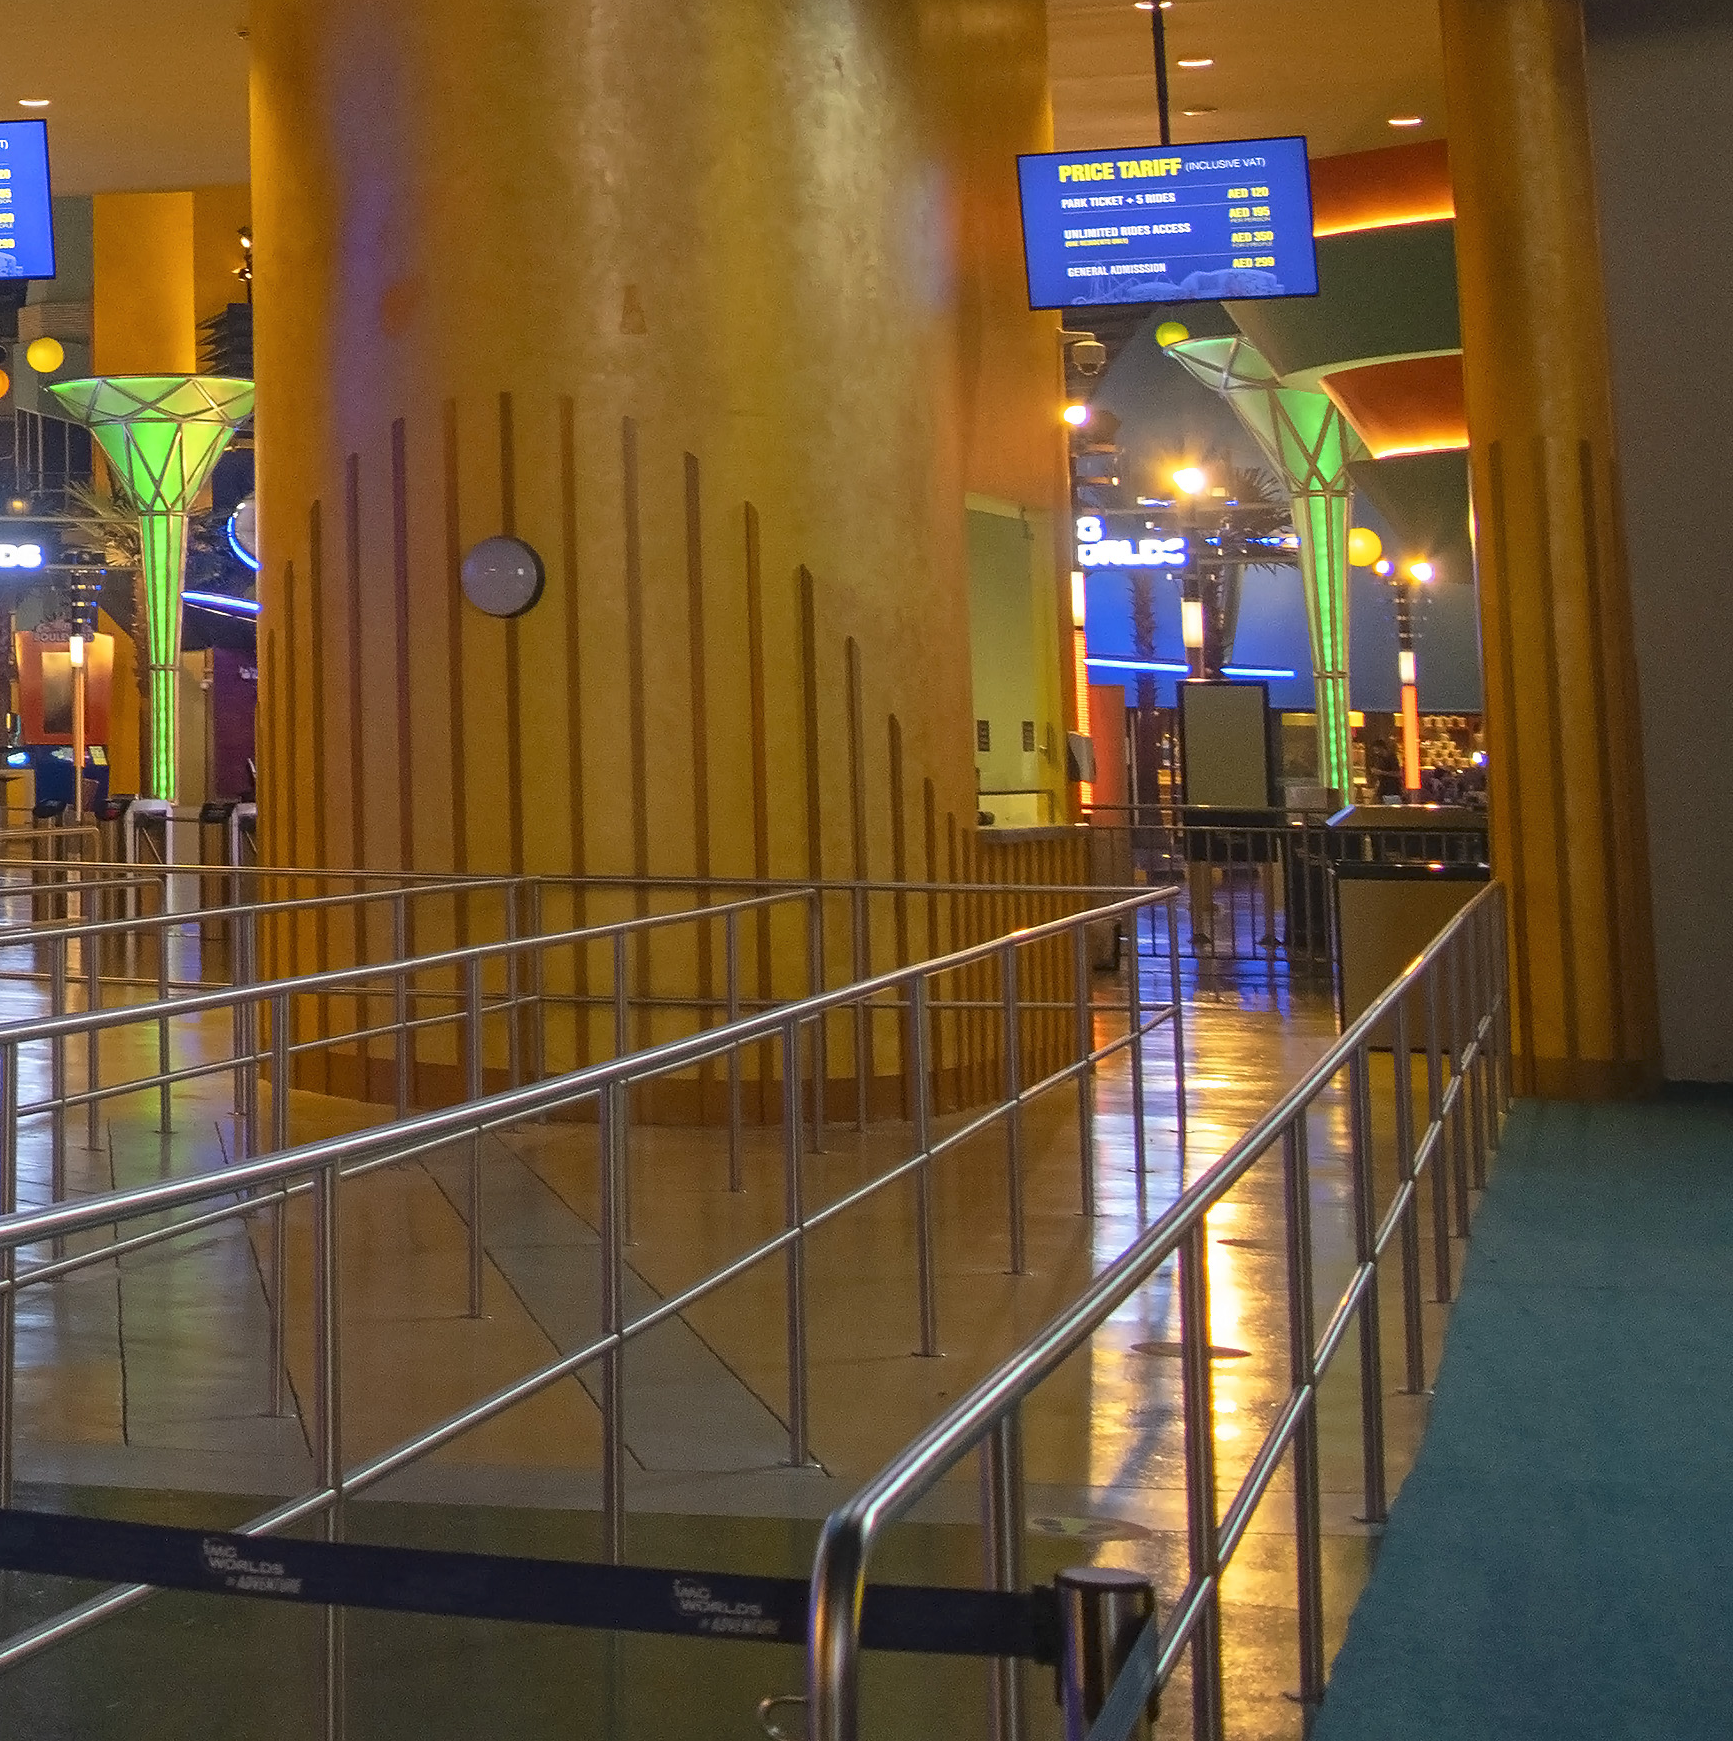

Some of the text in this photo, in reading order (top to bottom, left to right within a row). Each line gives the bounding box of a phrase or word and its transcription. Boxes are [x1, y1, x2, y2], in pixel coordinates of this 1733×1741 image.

[1059, 157, 1265, 183] PRICE TARIFF (INCLUSIVE VAT)
[1228, 187, 1269, 198] AED 120
[1062, 198, 1088, 209] PARK
[1090, 196, 1123, 208] TICKET
[1145, 193, 1176, 204] RIDES
[1229, 208, 1250, 218] AED
[1064, 223, 1191, 240] UNLIMITED RIDES ACCESS
[1232, 232, 1252, 242] AED
[1233, 258, 1252, 268] AED
[1067, 267, 1108, 277] GENERAL
